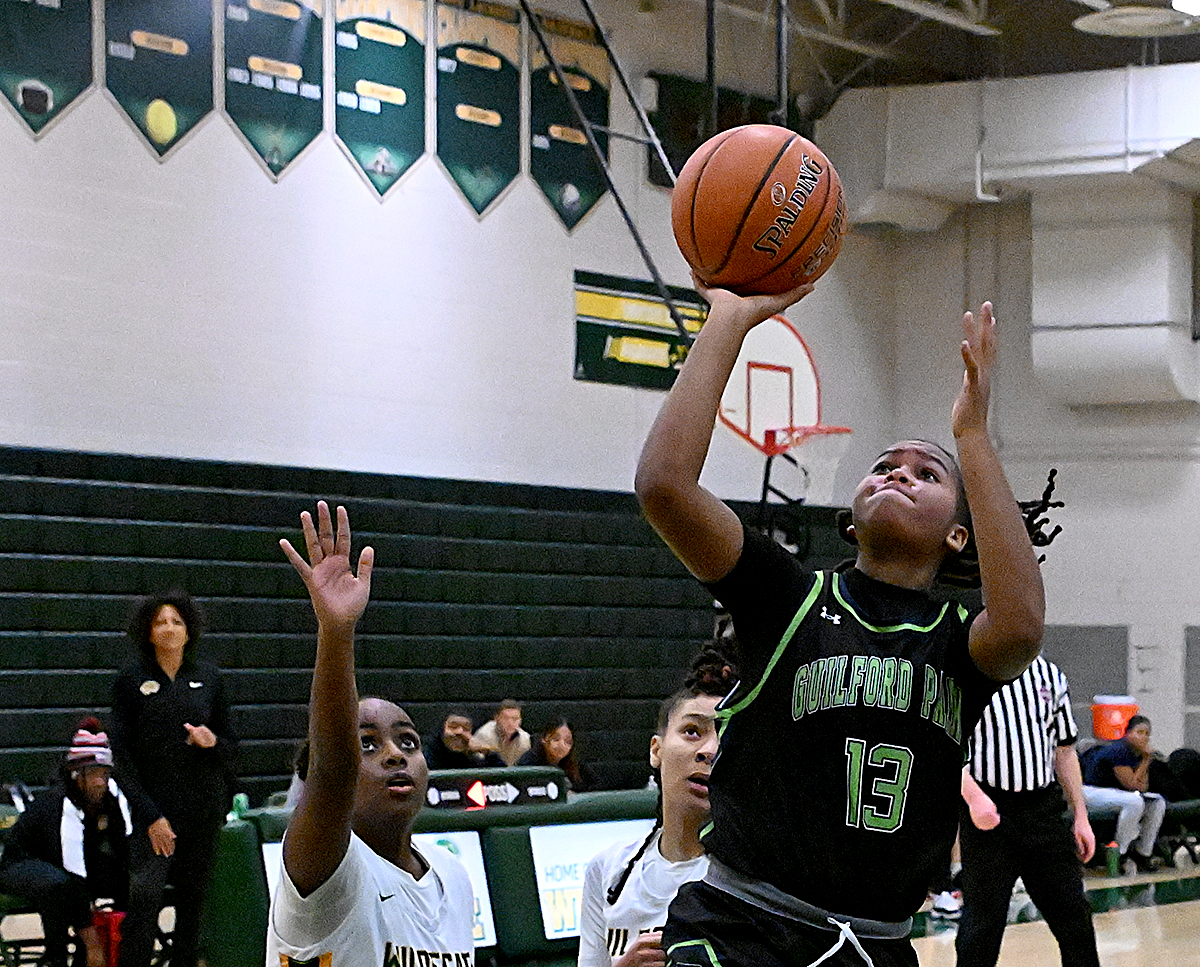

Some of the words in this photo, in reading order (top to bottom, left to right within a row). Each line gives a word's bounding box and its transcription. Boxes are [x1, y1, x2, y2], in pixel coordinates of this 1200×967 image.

[752, 153, 823, 260] SPALDING
[792, 655, 913, 722] GUILFORD
[845, 737, 915, 833] 13
